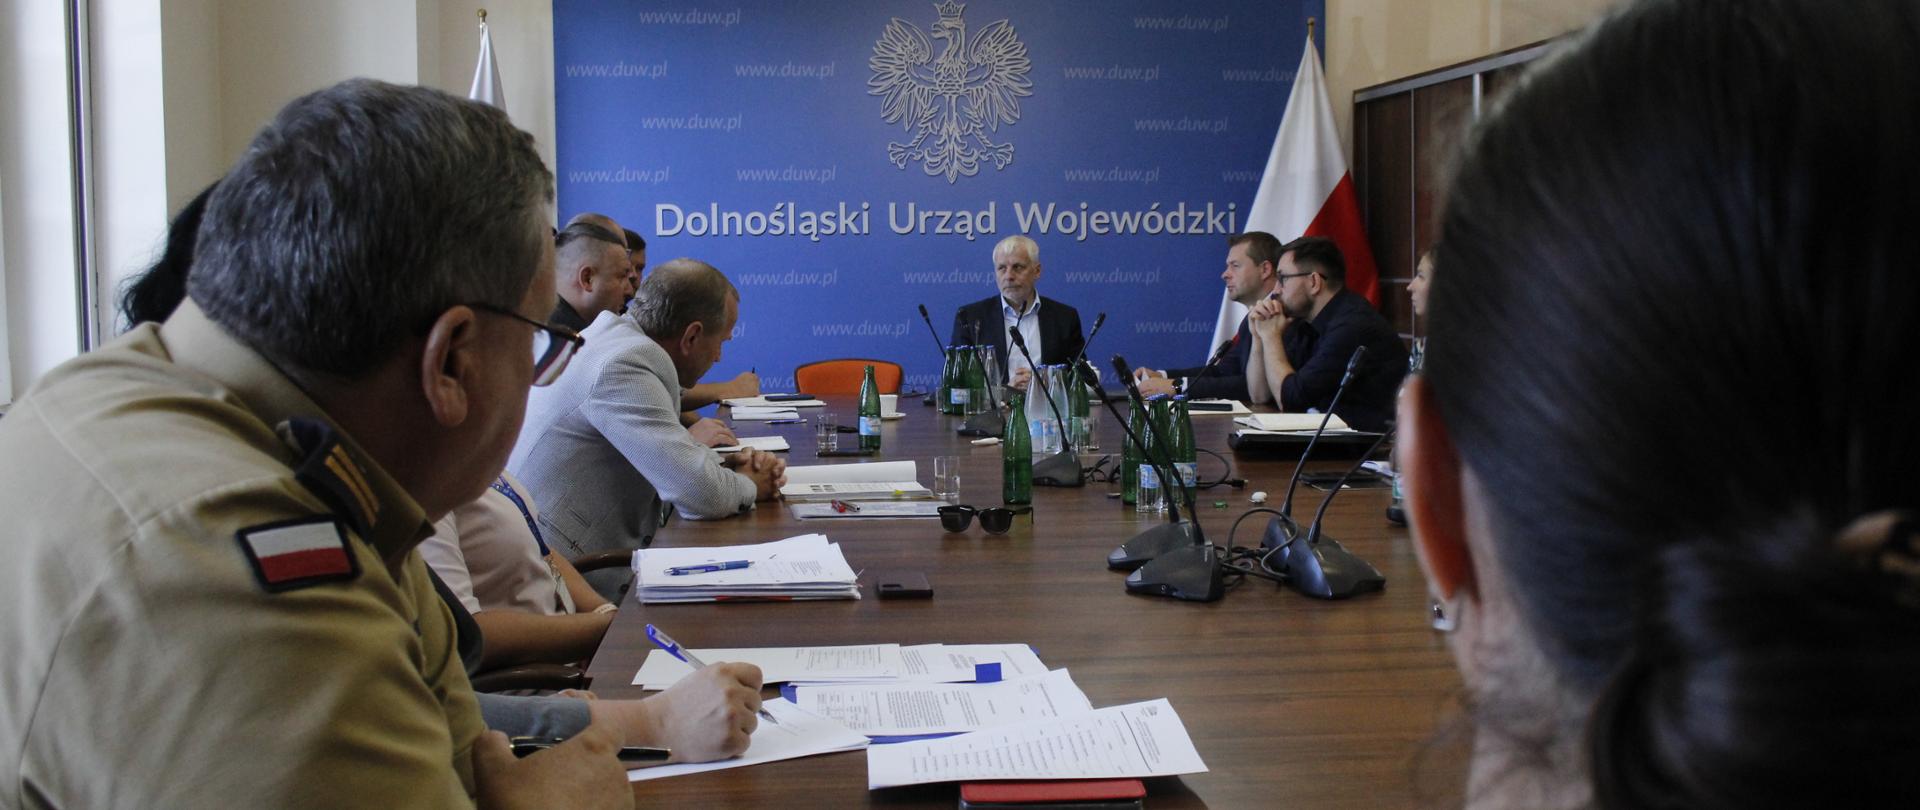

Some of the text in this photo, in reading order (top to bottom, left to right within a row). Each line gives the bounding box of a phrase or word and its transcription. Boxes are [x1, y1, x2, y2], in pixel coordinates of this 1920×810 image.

[640, 8, 740, 26] www.duw.pl
[1134, 14, 1229, 33] www.duw.pl
[566, 60, 668, 78] www.duw.pl
[735, 60, 835, 78] www.duw.pl
[1064, 64, 1159, 82] www.duw.pl
[1222, 67, 1297, 81] www.duw
[642, 114, 742, 131] www.duw.pl
[1134, 116, 1228, 134] www.duw.pl
[569, 166, 670, 184] www.duw.pl
[736, 165, 836, 183] www.duw.pl
[1064, 167, 1160, 185] www.duw.pl
[655, 201, 1236, 241] Dolnośląski Urząd Wojewódzki
[738, 268, 838, 286] www.duw.pl
[903, 269, 995, 287] www.duw.p
[1065, 267, 1160, 285] www.duw.pl
[812, 320, 911, 338] www.duw.pl
[1135, 317, 1215, 333] www.duw.
